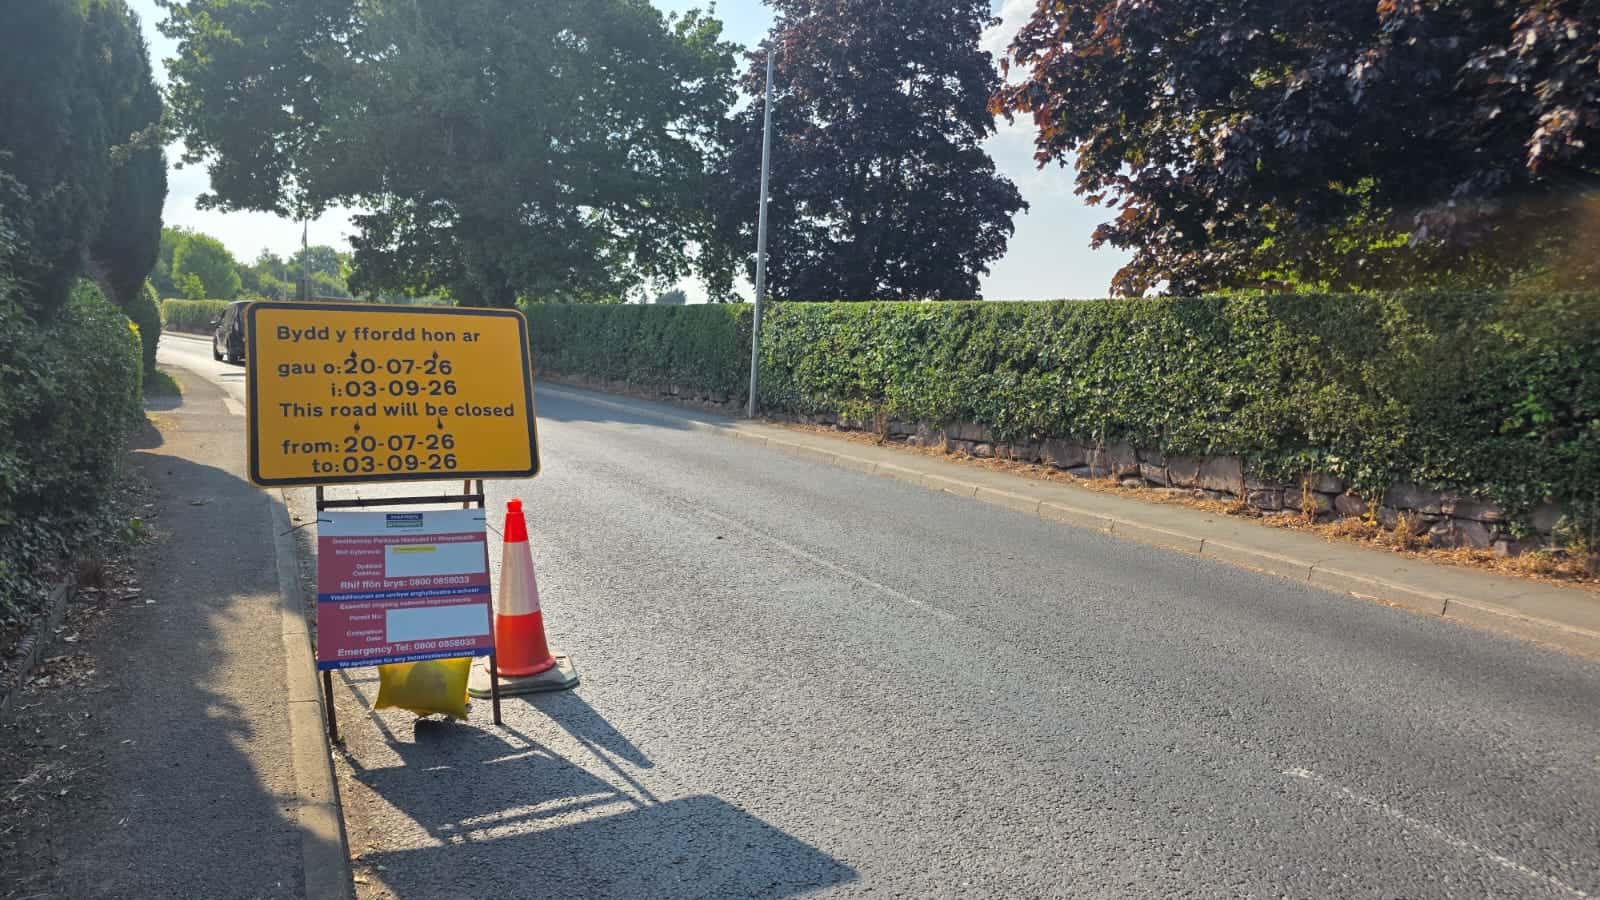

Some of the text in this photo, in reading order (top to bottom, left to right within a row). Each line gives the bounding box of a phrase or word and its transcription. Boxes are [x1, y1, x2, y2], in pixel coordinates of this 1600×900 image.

[277, 326, 480, 343] Bydd y ffordd hon ar
[278, 362, 316, 377] gau
[280, 402, 514, 417] This road will be closed
[340, 580, 360, 590] Rhif
[410, 577, 431, 586] 0800
[337, 646, 392, 657] Emergency
[395, 643, 412, 653] Tel:
[414, 642, 436, 650] 0800
